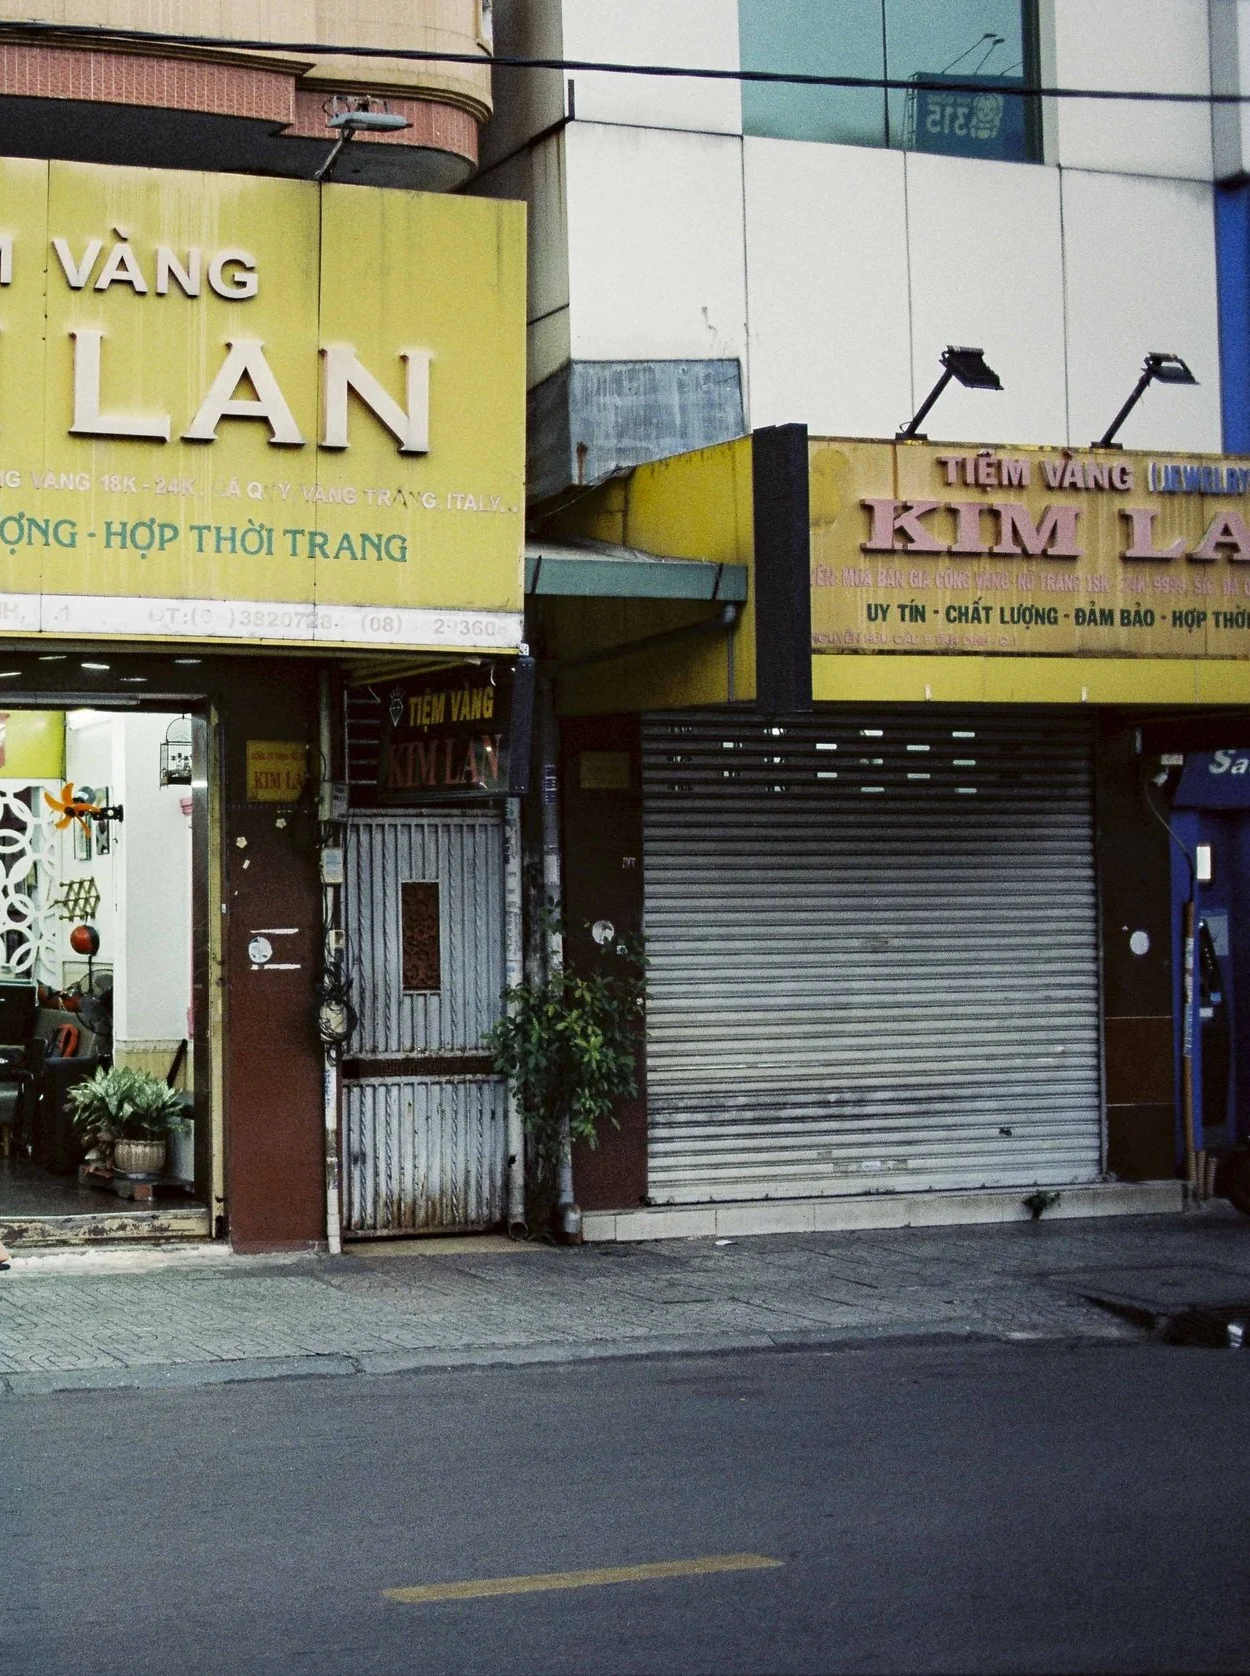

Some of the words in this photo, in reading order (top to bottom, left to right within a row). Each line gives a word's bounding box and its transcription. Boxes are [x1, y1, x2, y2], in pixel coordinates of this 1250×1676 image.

[51, 227, 258, 299] VÀNG
[67, 330, 435, 453] LAN
[31, 466, 91, 491] VÀNG
[101, 474, 136, 492] 18K
[937, 449, 1031, 494] TIỆM
[1041, 450, 1134, 491] VÀNG
[104, 517, 179, 560] HỢP
[190, 518, 274, 556] THỜI
[283, 528, 408, 563] TRANG
[860, 497, 1084, 559] KIM
[866, 603, 890, 622] UY
[897, 598, 926, 623] TÍN
[945, 597, 993, 625] CHẤT
[1000, 603, 1059, 630] LƯỢNG
[1075, 601, 1114, 627] ĐẢM
[1120, 602, 1155, 627] BẢO
[1172, 607, 1207, 633] HỢP
[409, 687, 446, 732] TIỆM
[451, 682, 494, 722] VÀNG
[387, 740, 439, 787] KIM
[443, 734, 502, 785] LAN
